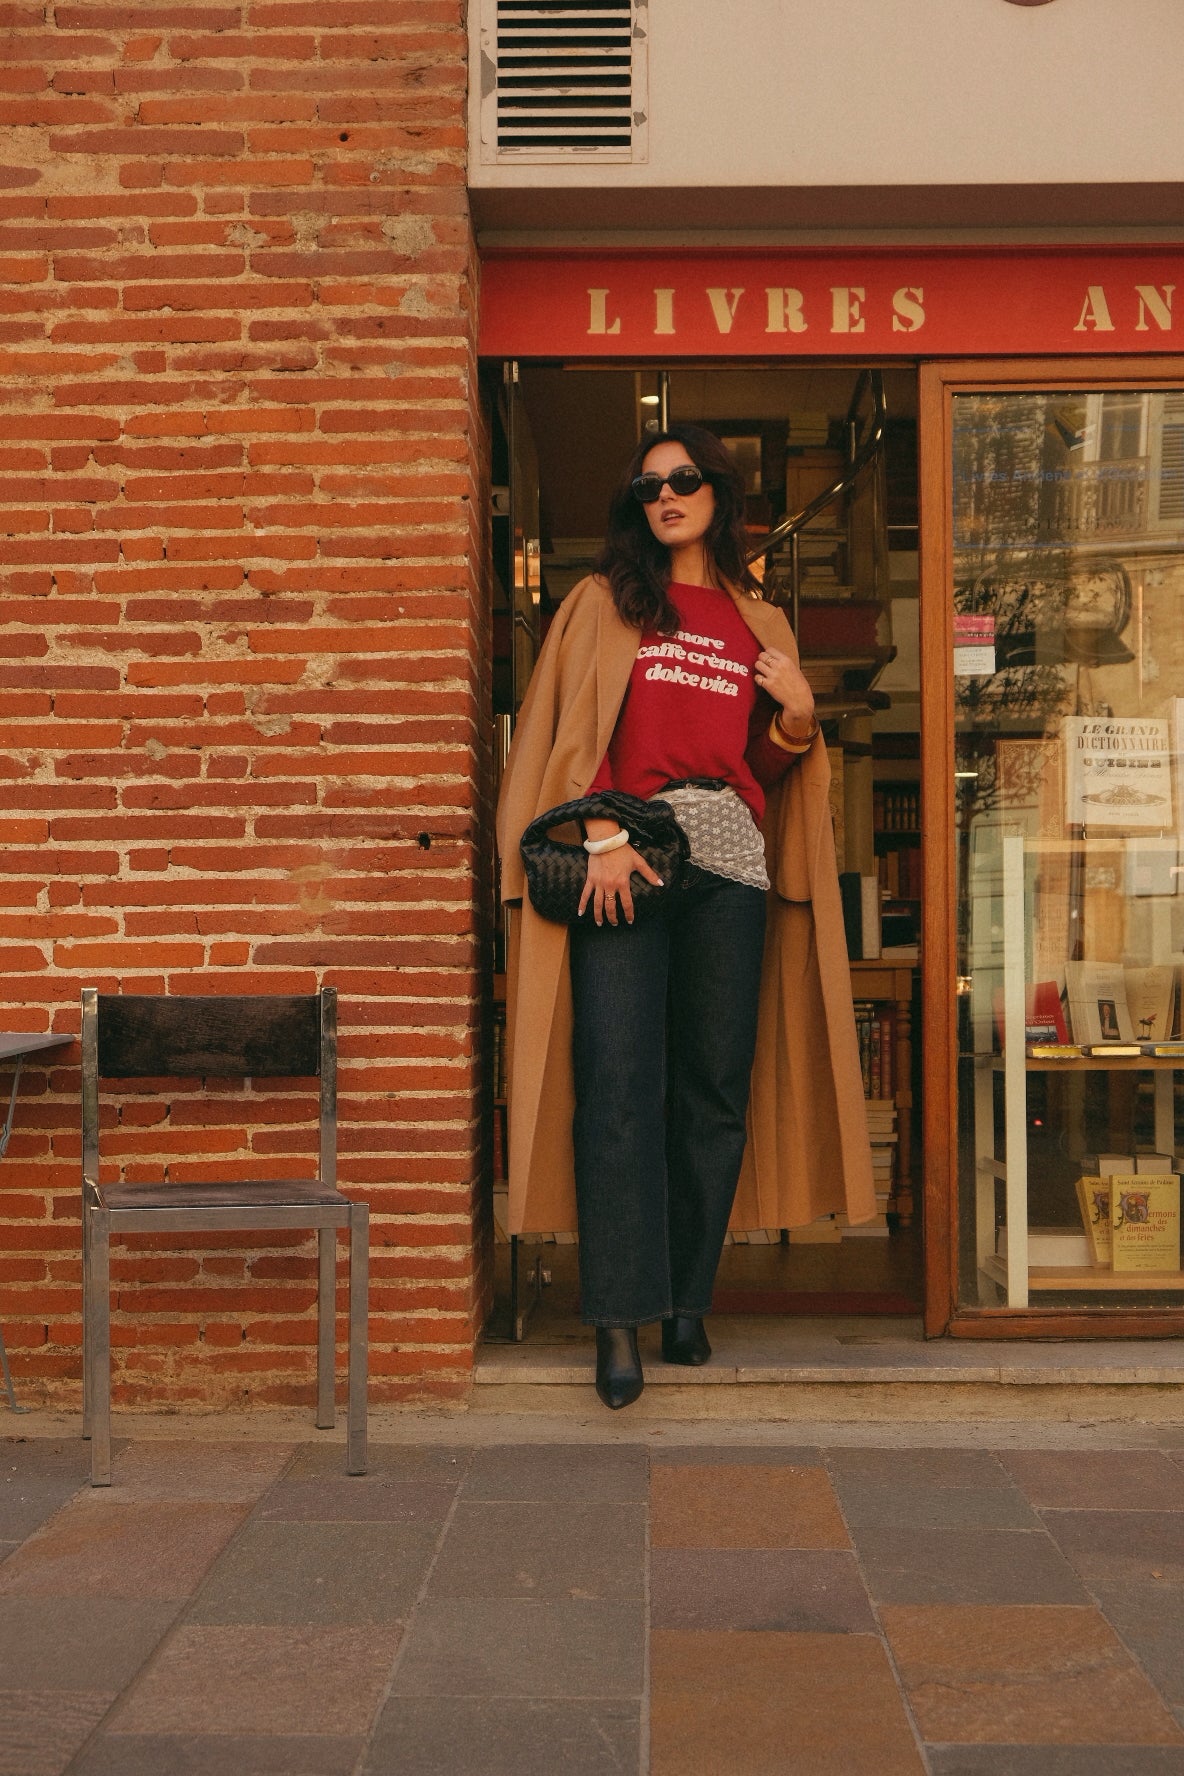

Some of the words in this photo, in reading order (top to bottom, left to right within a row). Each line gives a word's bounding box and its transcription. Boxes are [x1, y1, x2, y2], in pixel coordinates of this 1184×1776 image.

[587, 286, 926, 335] LIVRES
[1073, 284, 1178, 333] AN
[687, 652, 749, 677] crème
[645, 663, 700, 687] dolce
[700, 675, 739, 697] vita
[1082, 724, 1101, 734] LE
[1105, 725, 1160, 735] GRAND
[1077, 736, 1168, 751] DICTIONNAIRE
[1126, 1224, 1166, 1232] dimanches
